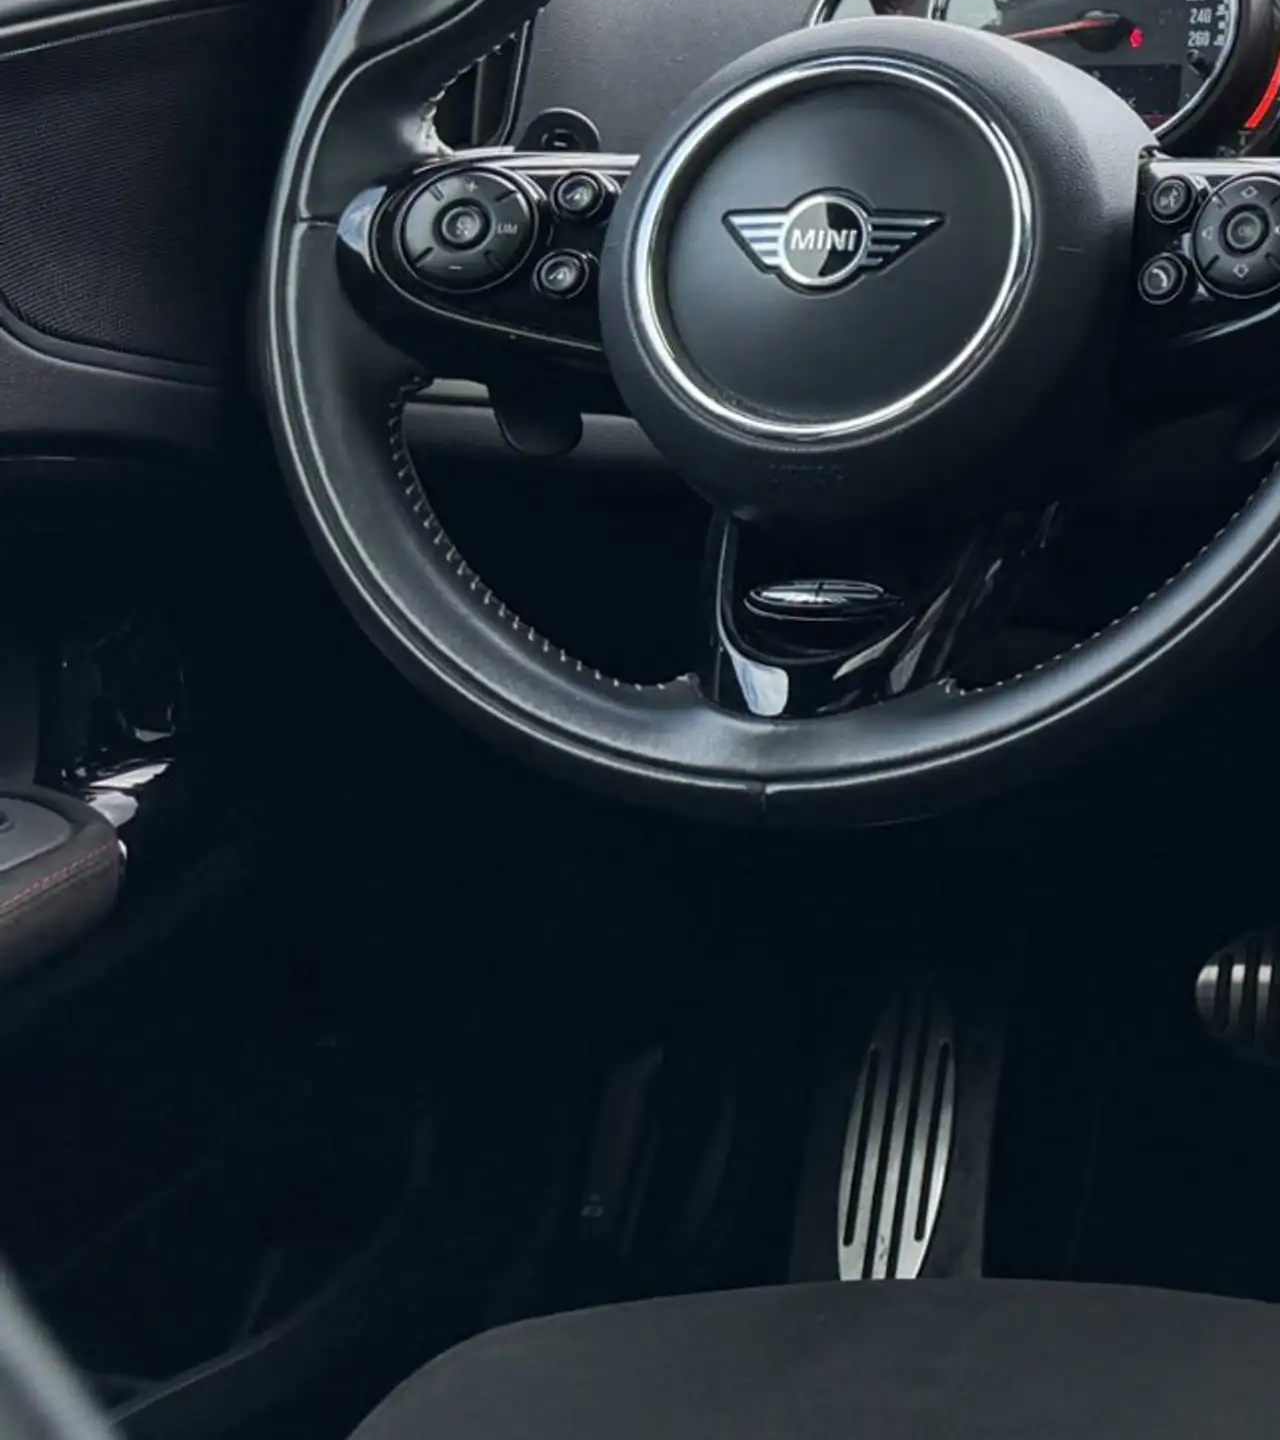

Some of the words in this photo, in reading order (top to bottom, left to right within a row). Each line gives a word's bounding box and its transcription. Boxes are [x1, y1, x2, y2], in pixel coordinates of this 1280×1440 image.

[1189, 8, 1212, 24] 240
[1187, 30, 1211, 47] 260
[790, 228, 858, 251] MINI
